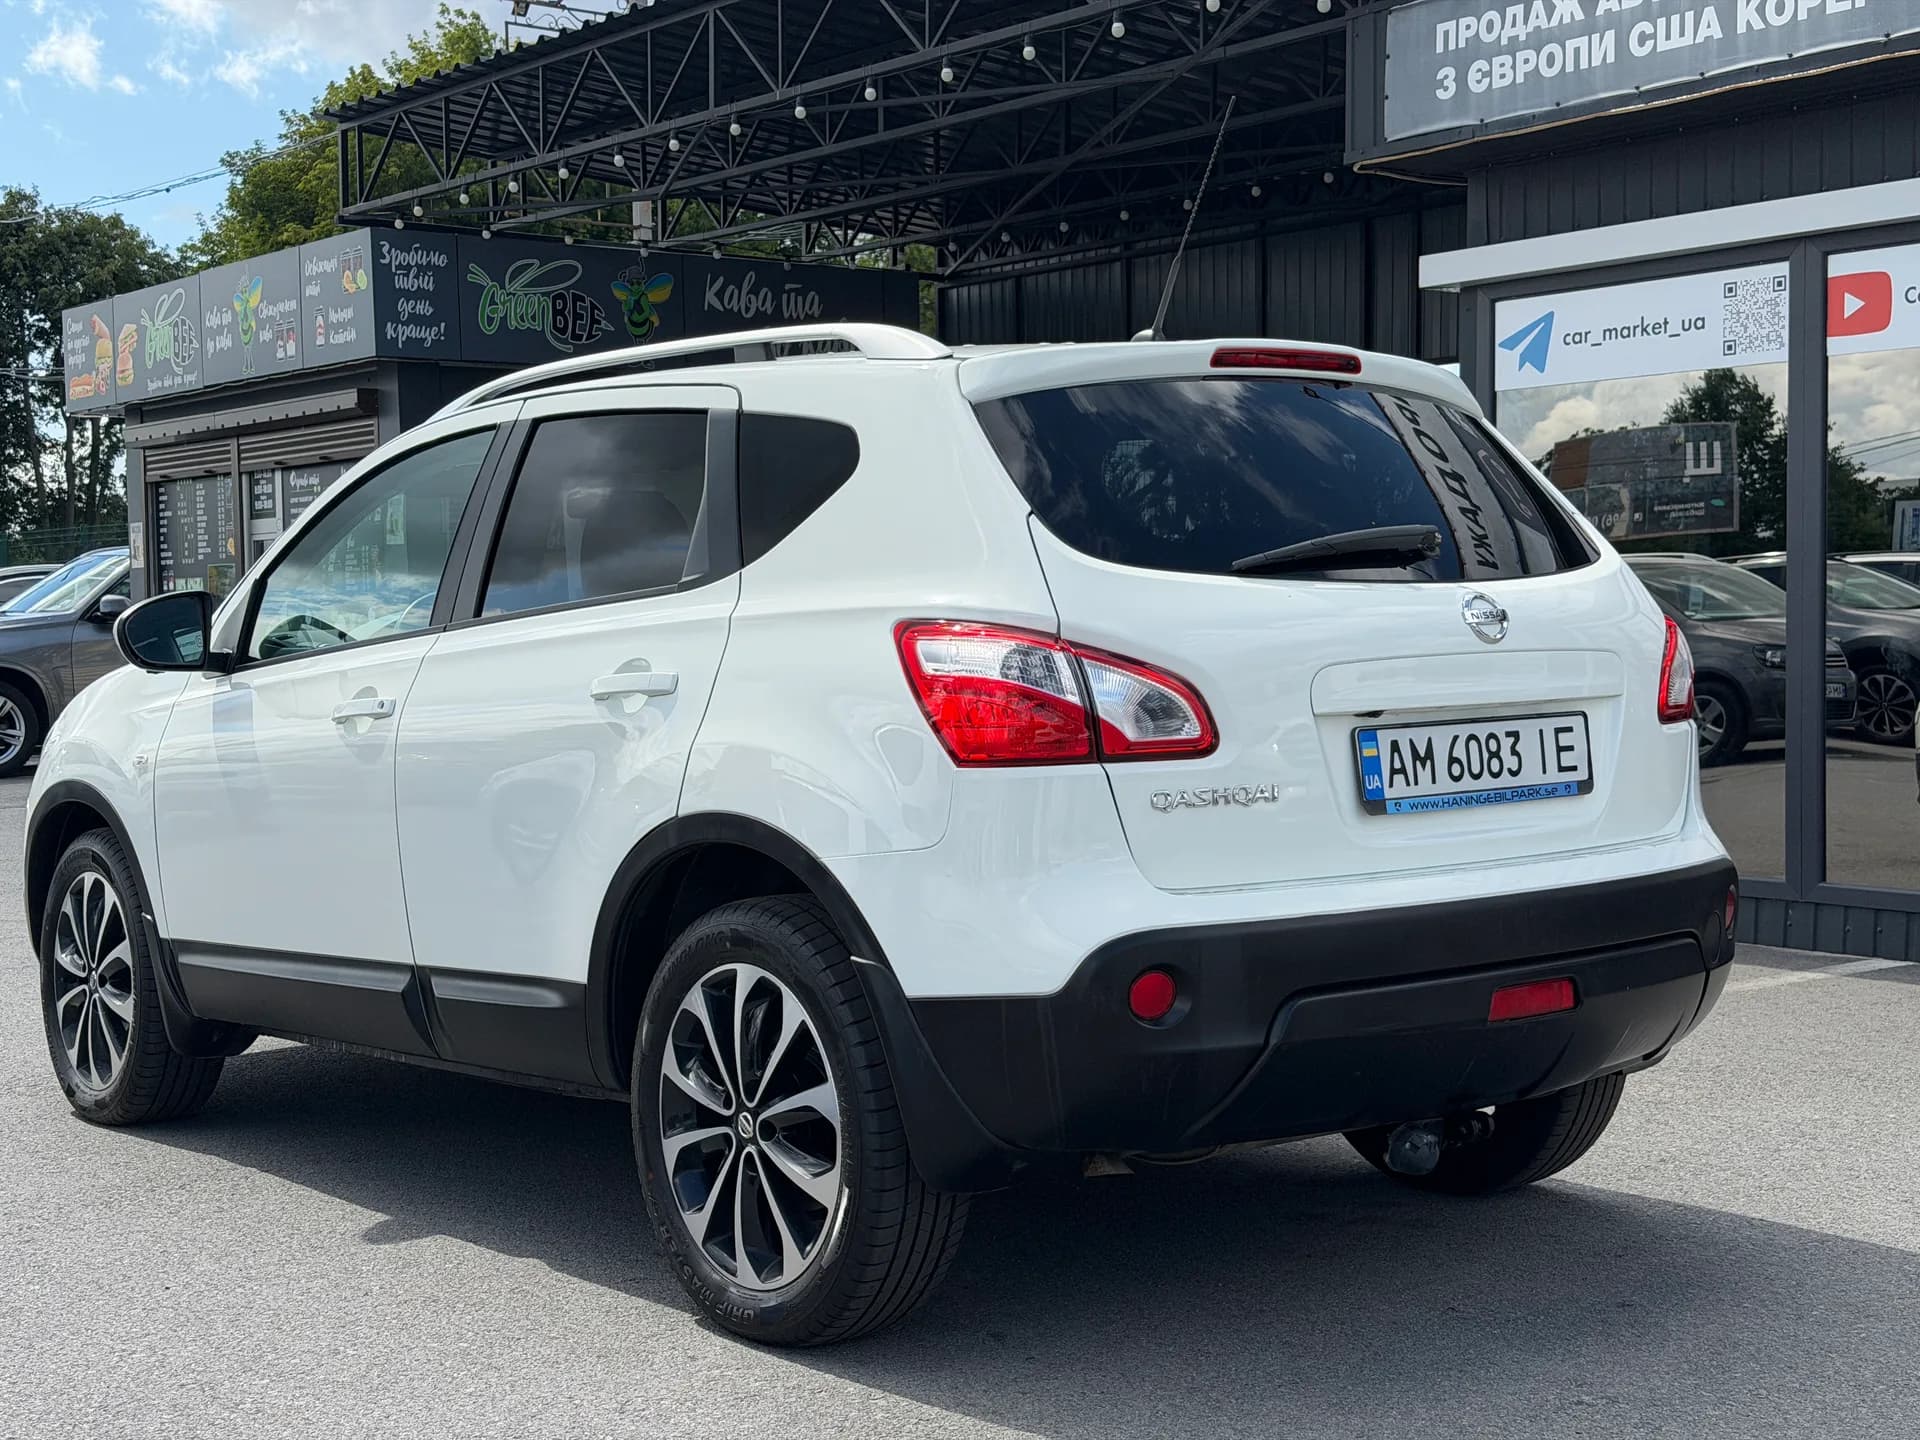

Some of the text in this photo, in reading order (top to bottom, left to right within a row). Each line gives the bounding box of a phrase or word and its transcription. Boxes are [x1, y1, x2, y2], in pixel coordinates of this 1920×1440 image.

[1436, 0, 1585, 54] ПРОДАЖ
[1467, 29, 1616, 94] ЄВРОПИ
[1628, 6, 1723, 58] США
[1736, 0, 1866, 34] КОР
[379, 241, 448, 273] Зробимо
[394, 266, 436, 291] твій
[397, 297, 434, 321] день
[704, 271, 824, 320] Кава та
[385, 321, 446, 349] краще!
[1563, 316, 1706, 347] car_market_ua
[1388, 726, 1578, 788] AM 6083 IE
[1365, 775, 1382, 790] UA
[1150, 783, 1280, 814] QASHQAI
